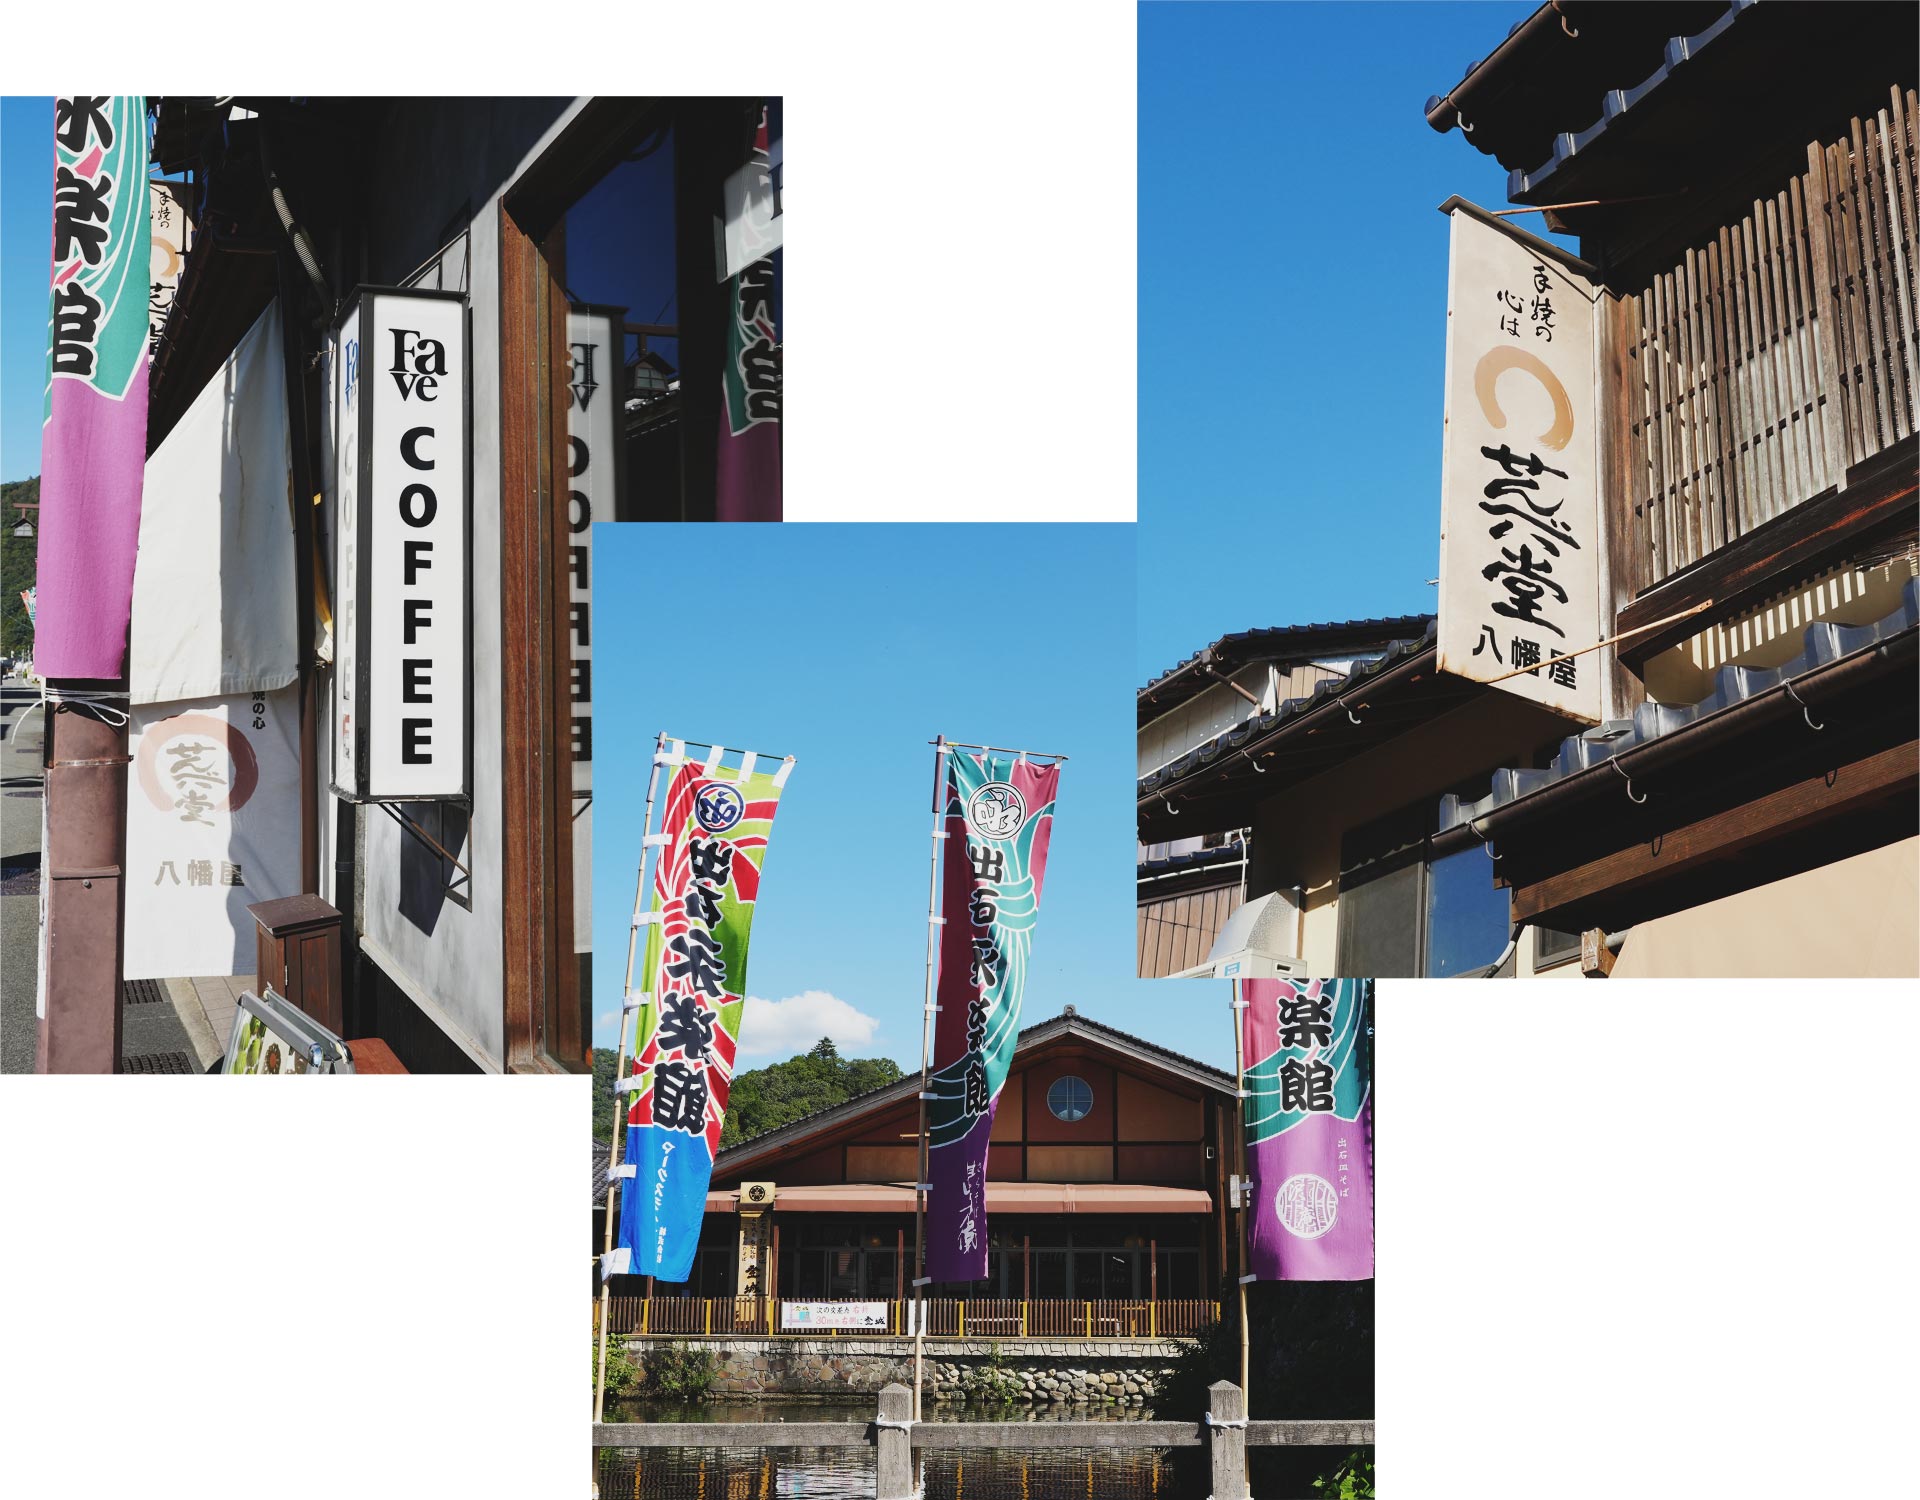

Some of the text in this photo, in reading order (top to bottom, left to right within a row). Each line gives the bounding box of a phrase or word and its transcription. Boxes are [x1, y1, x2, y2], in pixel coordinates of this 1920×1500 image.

[1497, 290, 1524, 338] 心は
[1531, 266, 1556, 343] 手焼の
[399, 426, 438, 764] COFFEE
[1472, 624, 1578, 691] 八幡屋
[154, 859, 245, 887] 八幡屋
[1277, 978, 1336, 1113] 楽館
